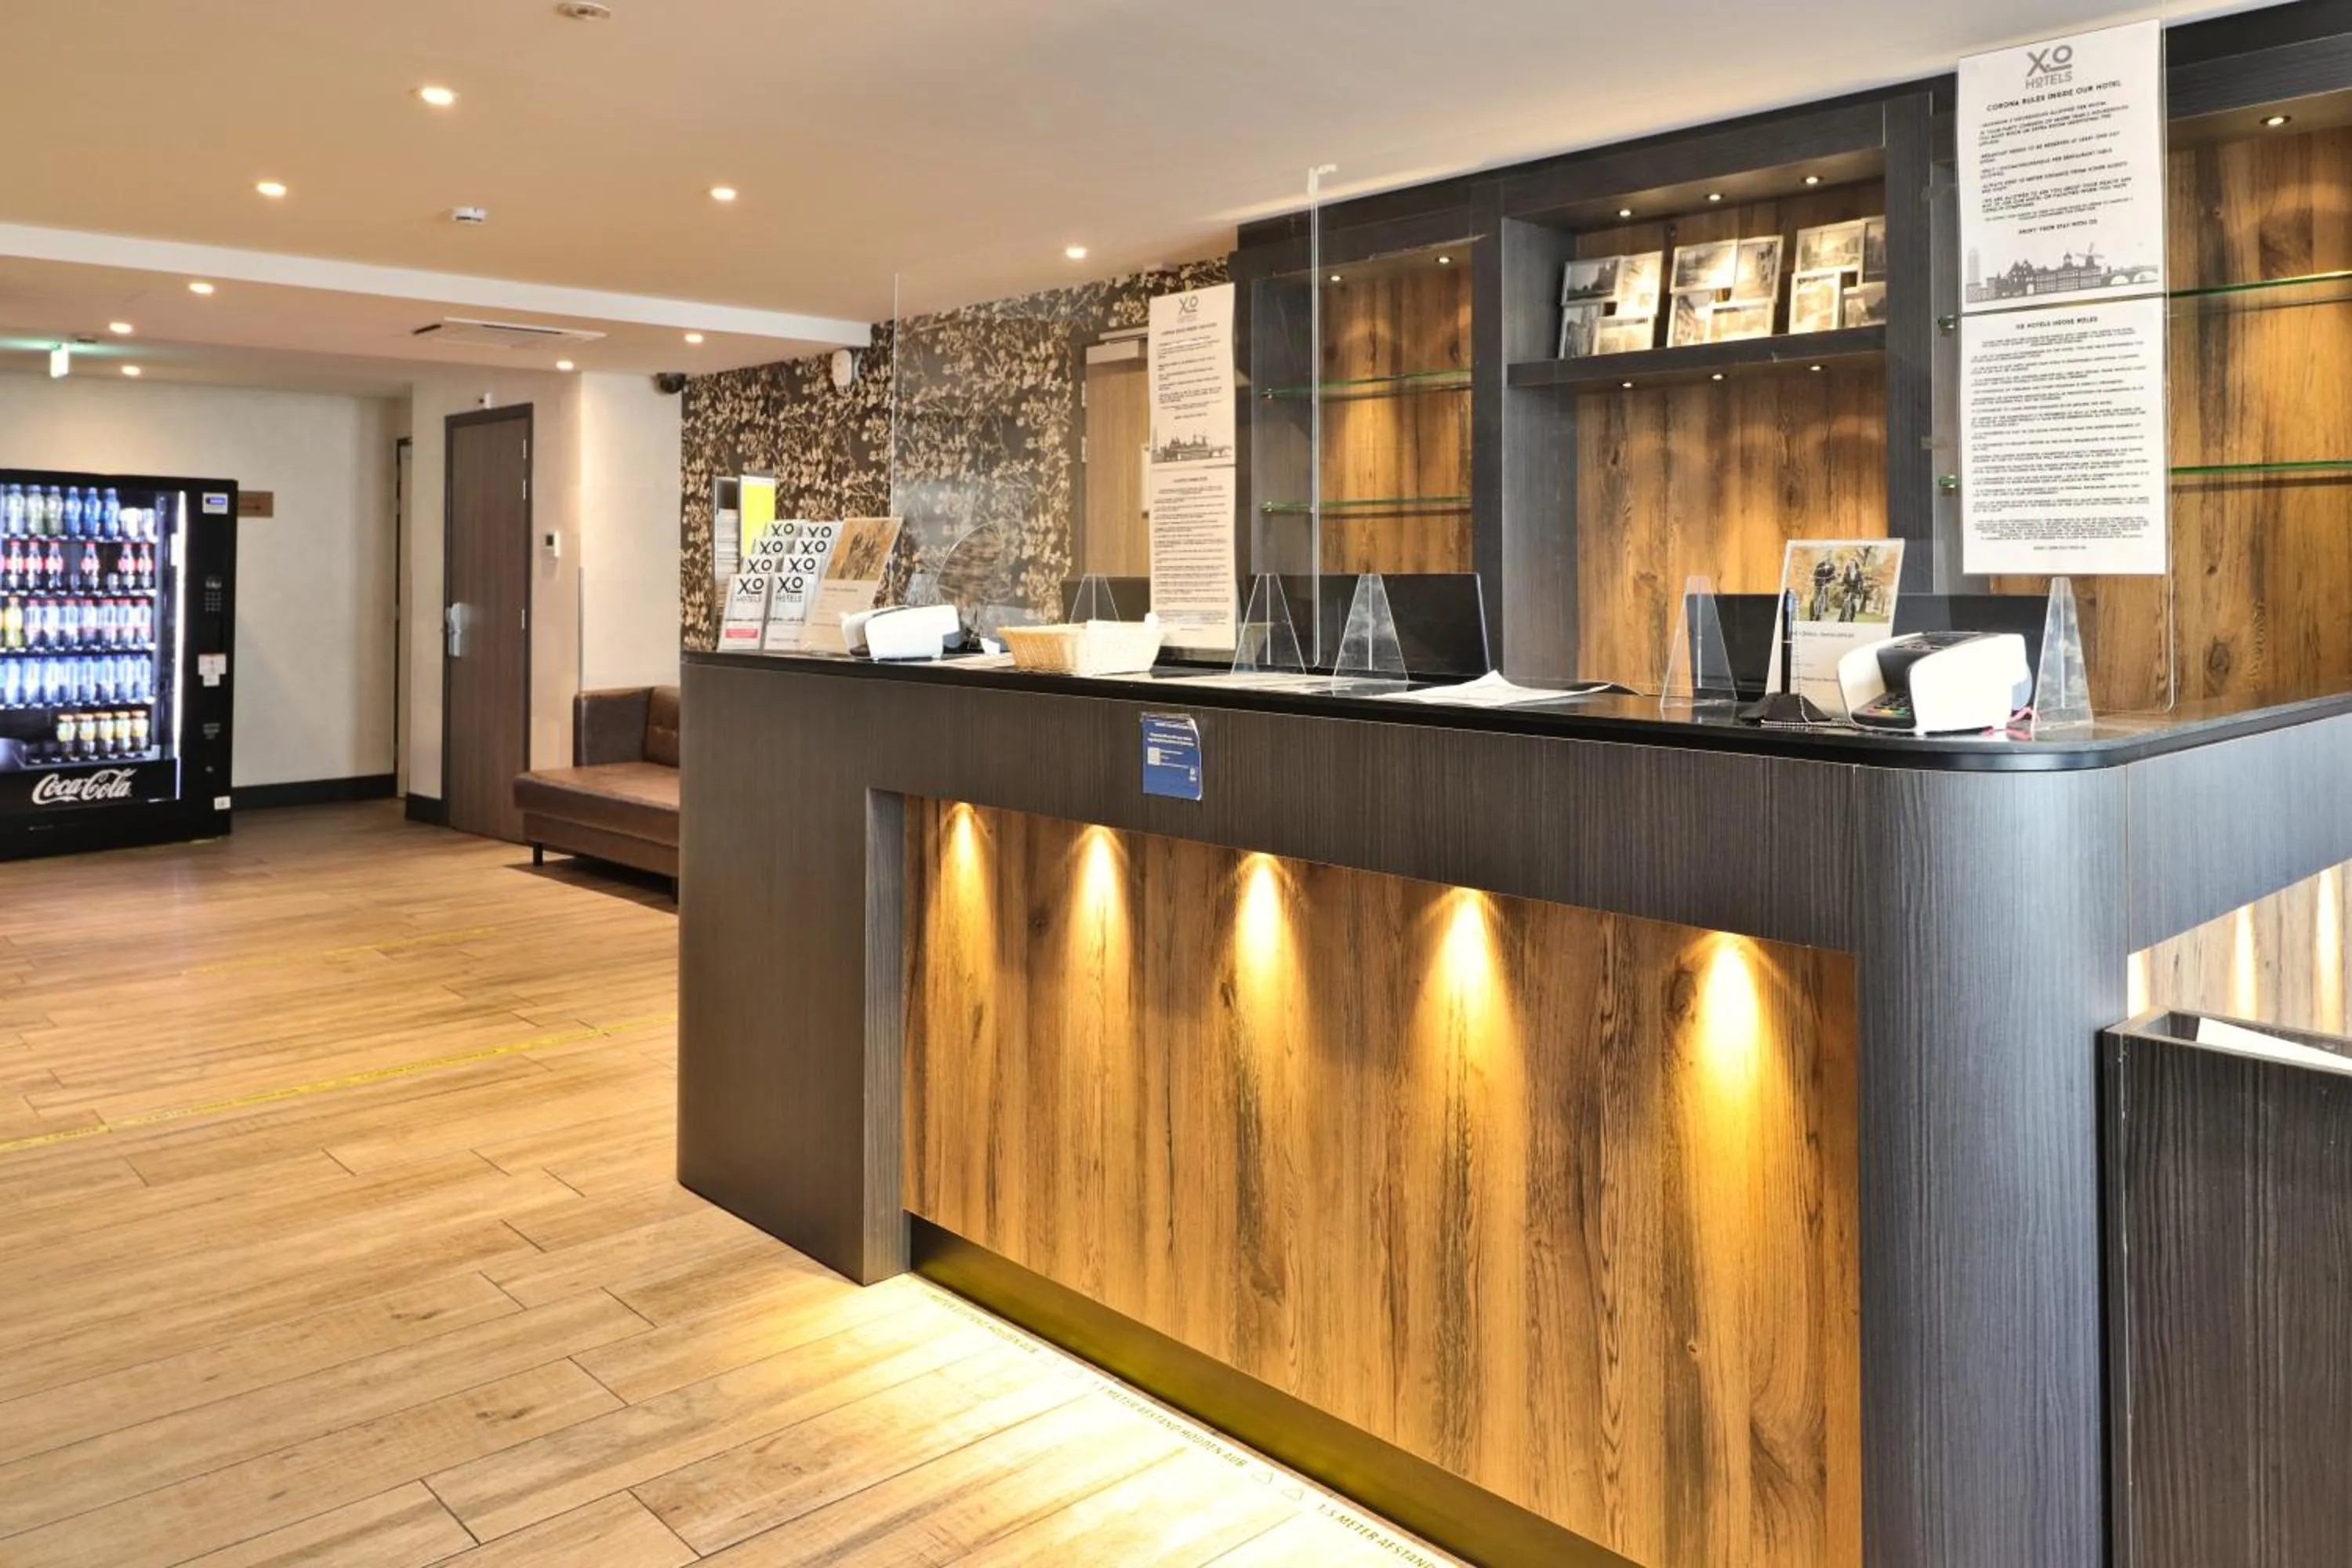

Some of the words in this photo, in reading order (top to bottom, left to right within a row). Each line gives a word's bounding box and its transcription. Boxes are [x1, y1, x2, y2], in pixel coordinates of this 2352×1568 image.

[2025, 71, 2073, 89] HOTELS
[1986, 100, 2019, 111] CORONA
[2076, 85, 2093, 95] OUR
[31, 768, 138, 805] Coca-Cola
[1336, 1514, 1380, 1541] METER
